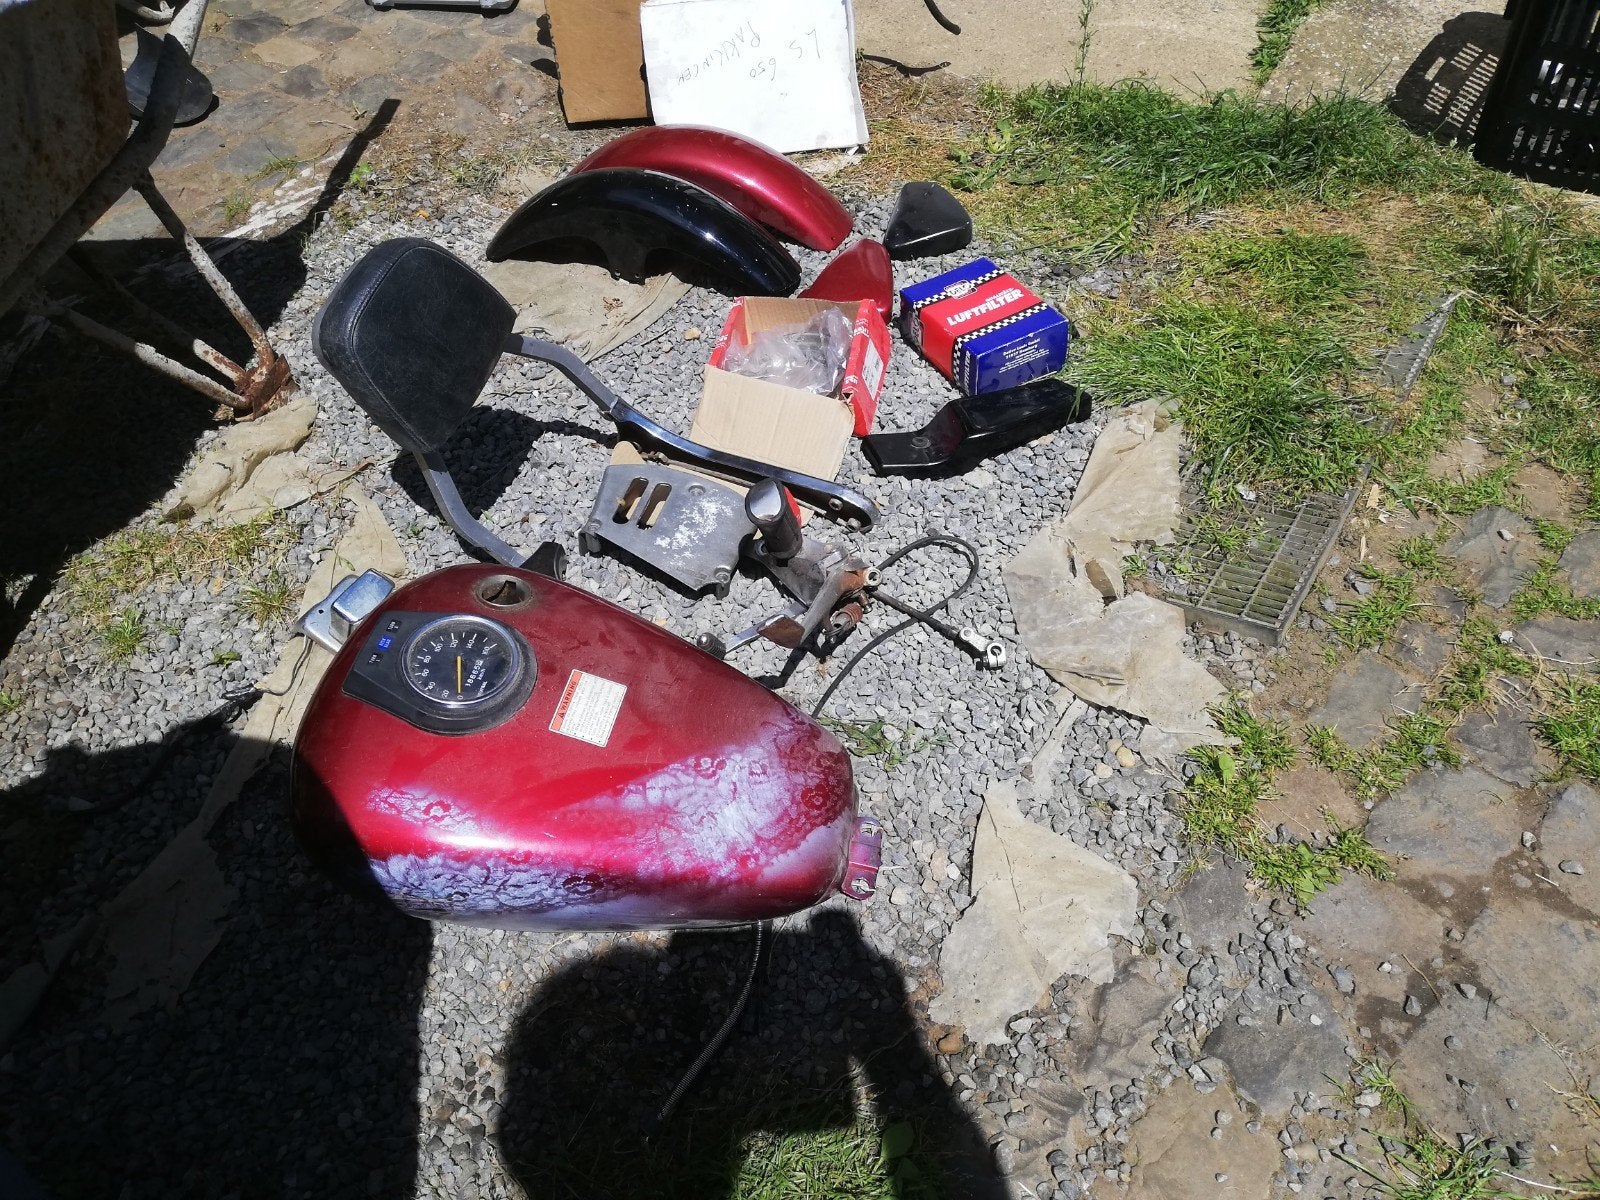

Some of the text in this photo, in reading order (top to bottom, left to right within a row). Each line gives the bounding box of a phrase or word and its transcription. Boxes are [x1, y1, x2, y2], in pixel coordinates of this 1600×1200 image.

[749, 58, 777, 81] 650
[946, 288, 1024, 326] LUFTFILTER
[450, 639, 459, 649] 120
[423, 655, 432, 664] 80
[421, 668, 430, 677] 60
[427, 681, 436, 690] 40
[441, 689, 450, 699] 20
[561, 681, 577, 711] WARNING
